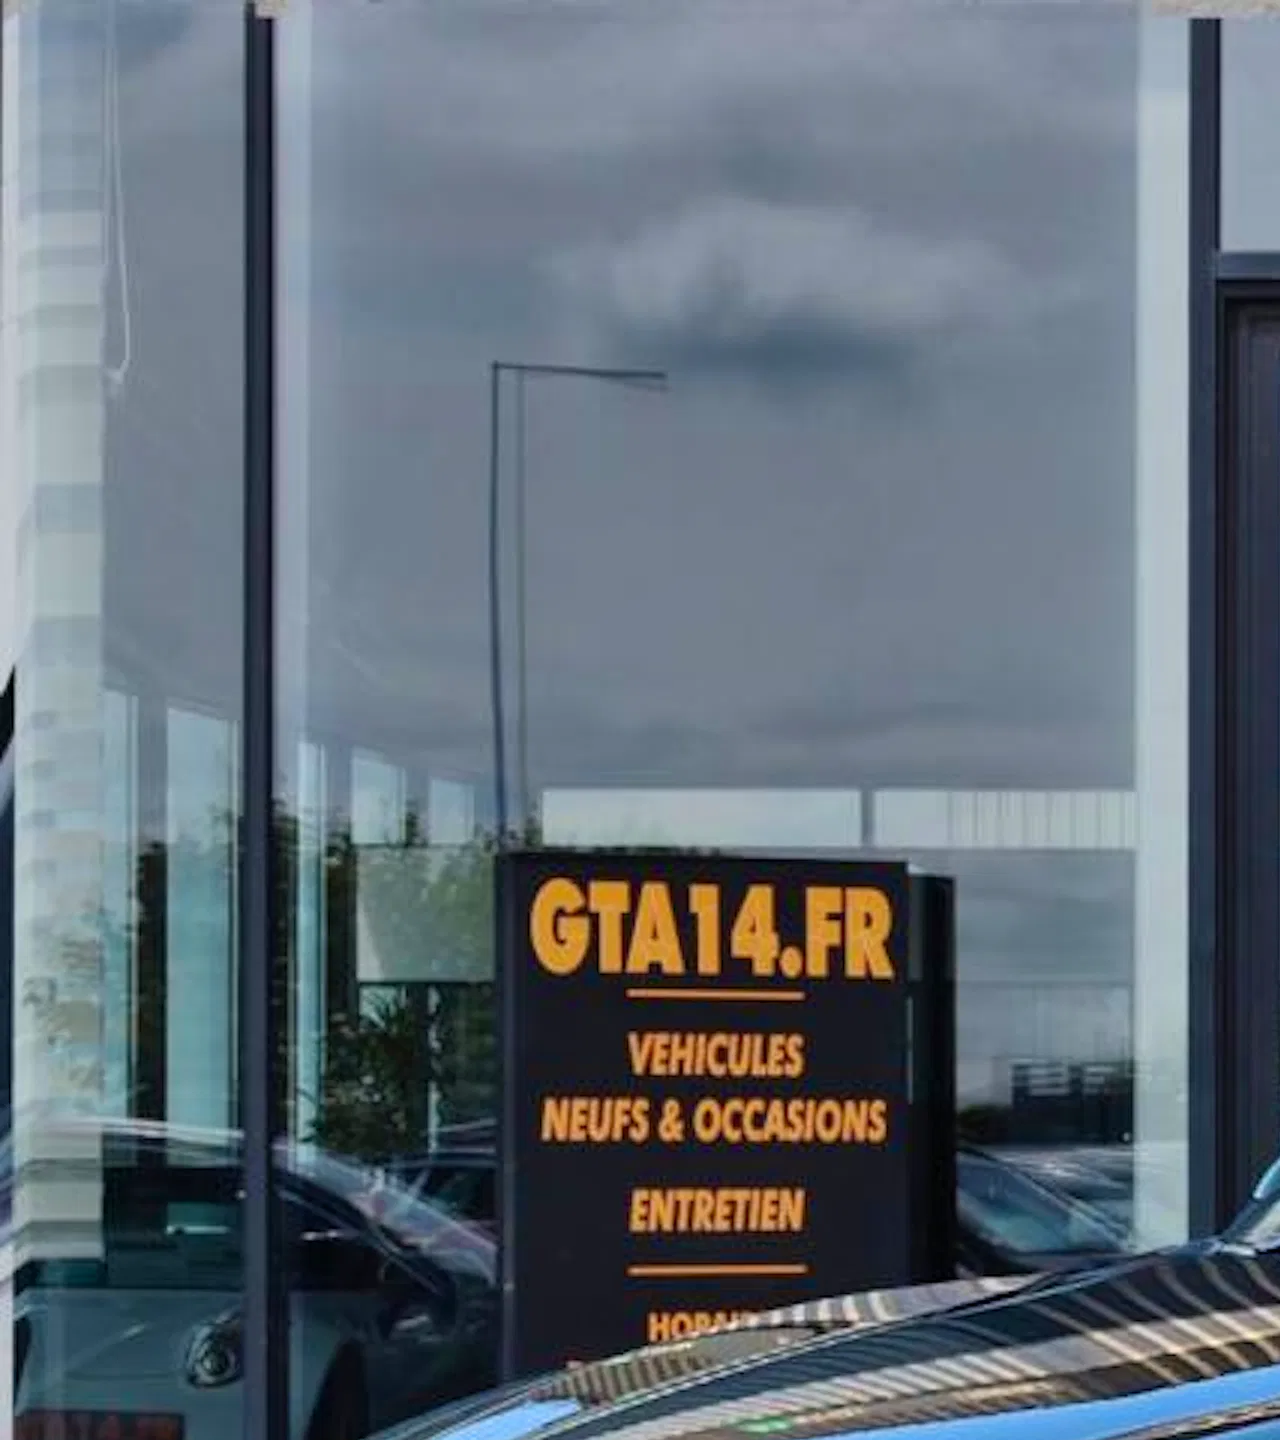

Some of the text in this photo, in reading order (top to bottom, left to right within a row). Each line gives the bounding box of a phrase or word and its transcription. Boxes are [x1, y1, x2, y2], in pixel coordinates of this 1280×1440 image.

[530, 876, 894, 979] GTA14.FR
[629, 1031, 804, 1078] VEHICULES
[541, 1097, 888, 1142] NEUFS & OCCASIONS
[629, 1187, 806, 1232] ENTRETIEN
